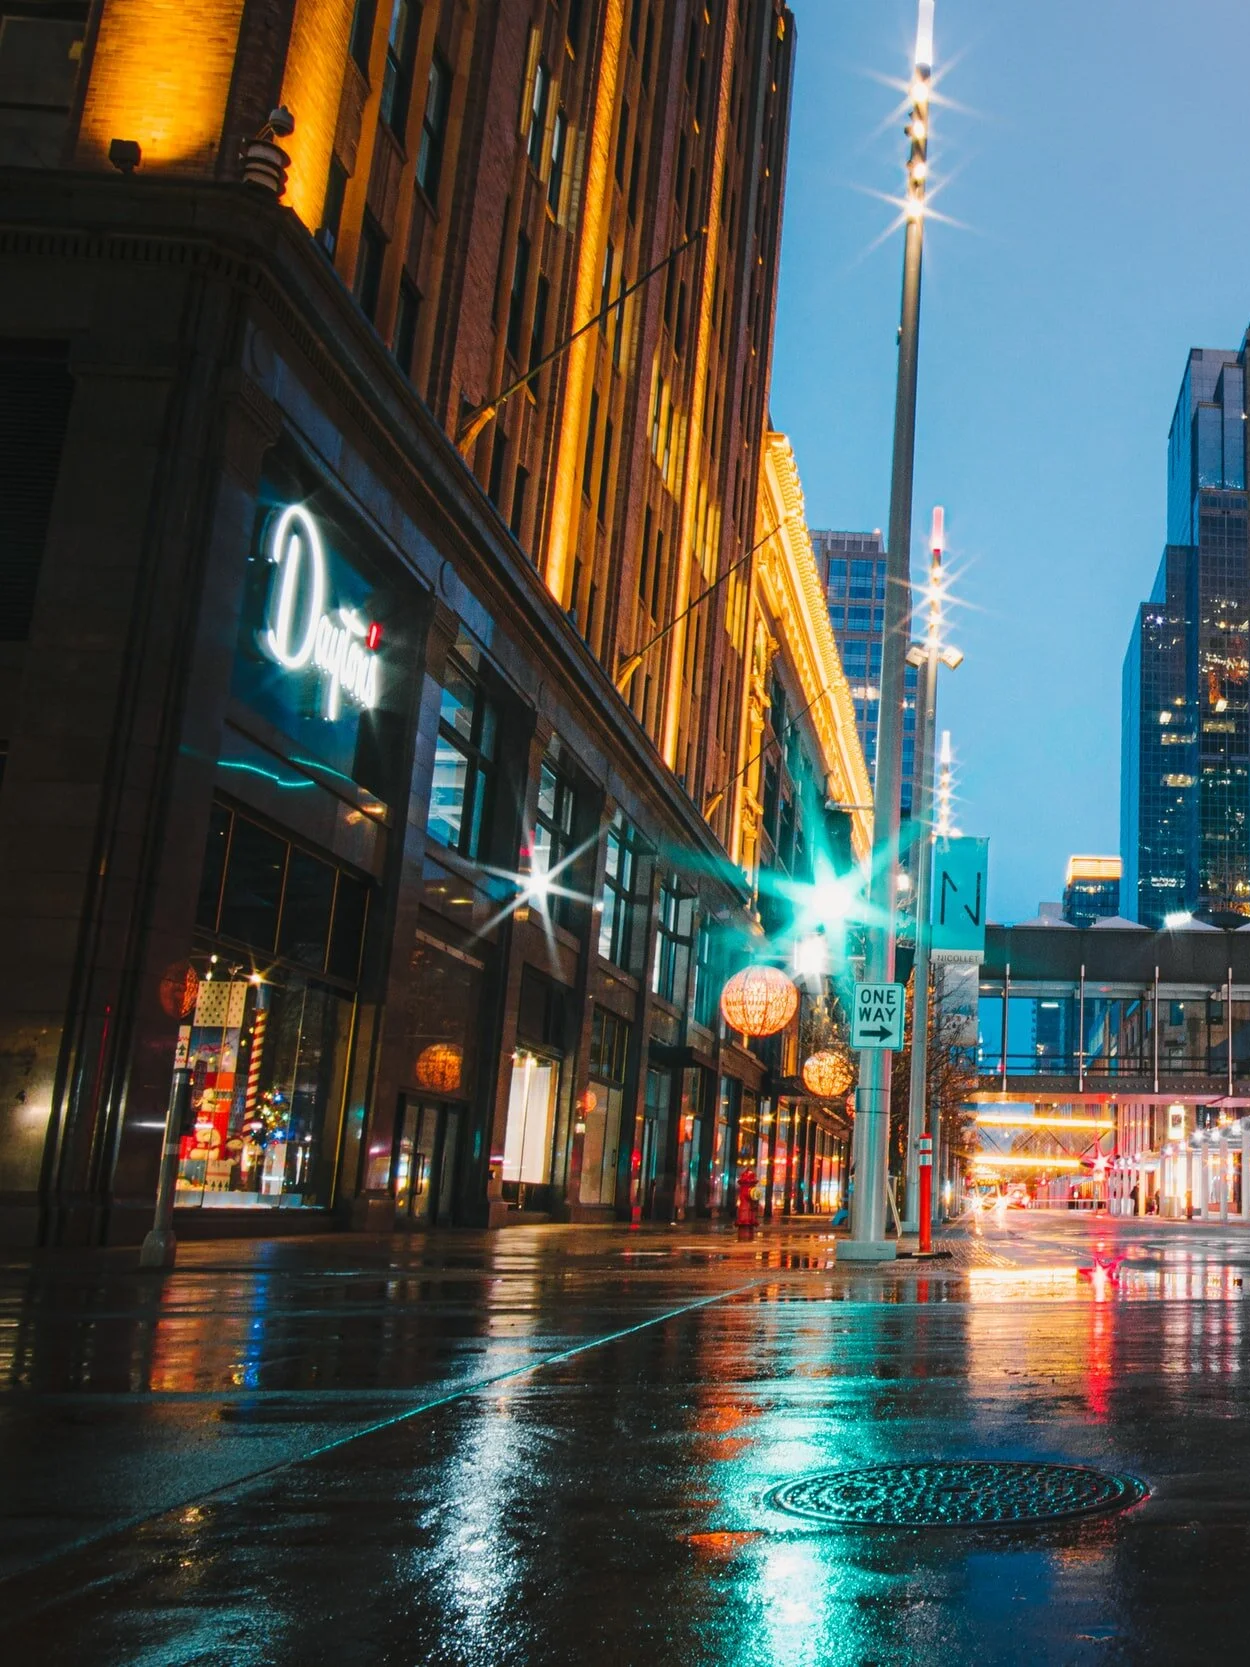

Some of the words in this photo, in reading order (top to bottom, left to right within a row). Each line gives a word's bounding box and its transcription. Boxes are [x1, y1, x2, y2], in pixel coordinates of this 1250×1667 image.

[937, 954, 978, 963] NICOLLET
[861, 989, 896, 1005] ONE
[859, 1007, 897, 1022] WAY
